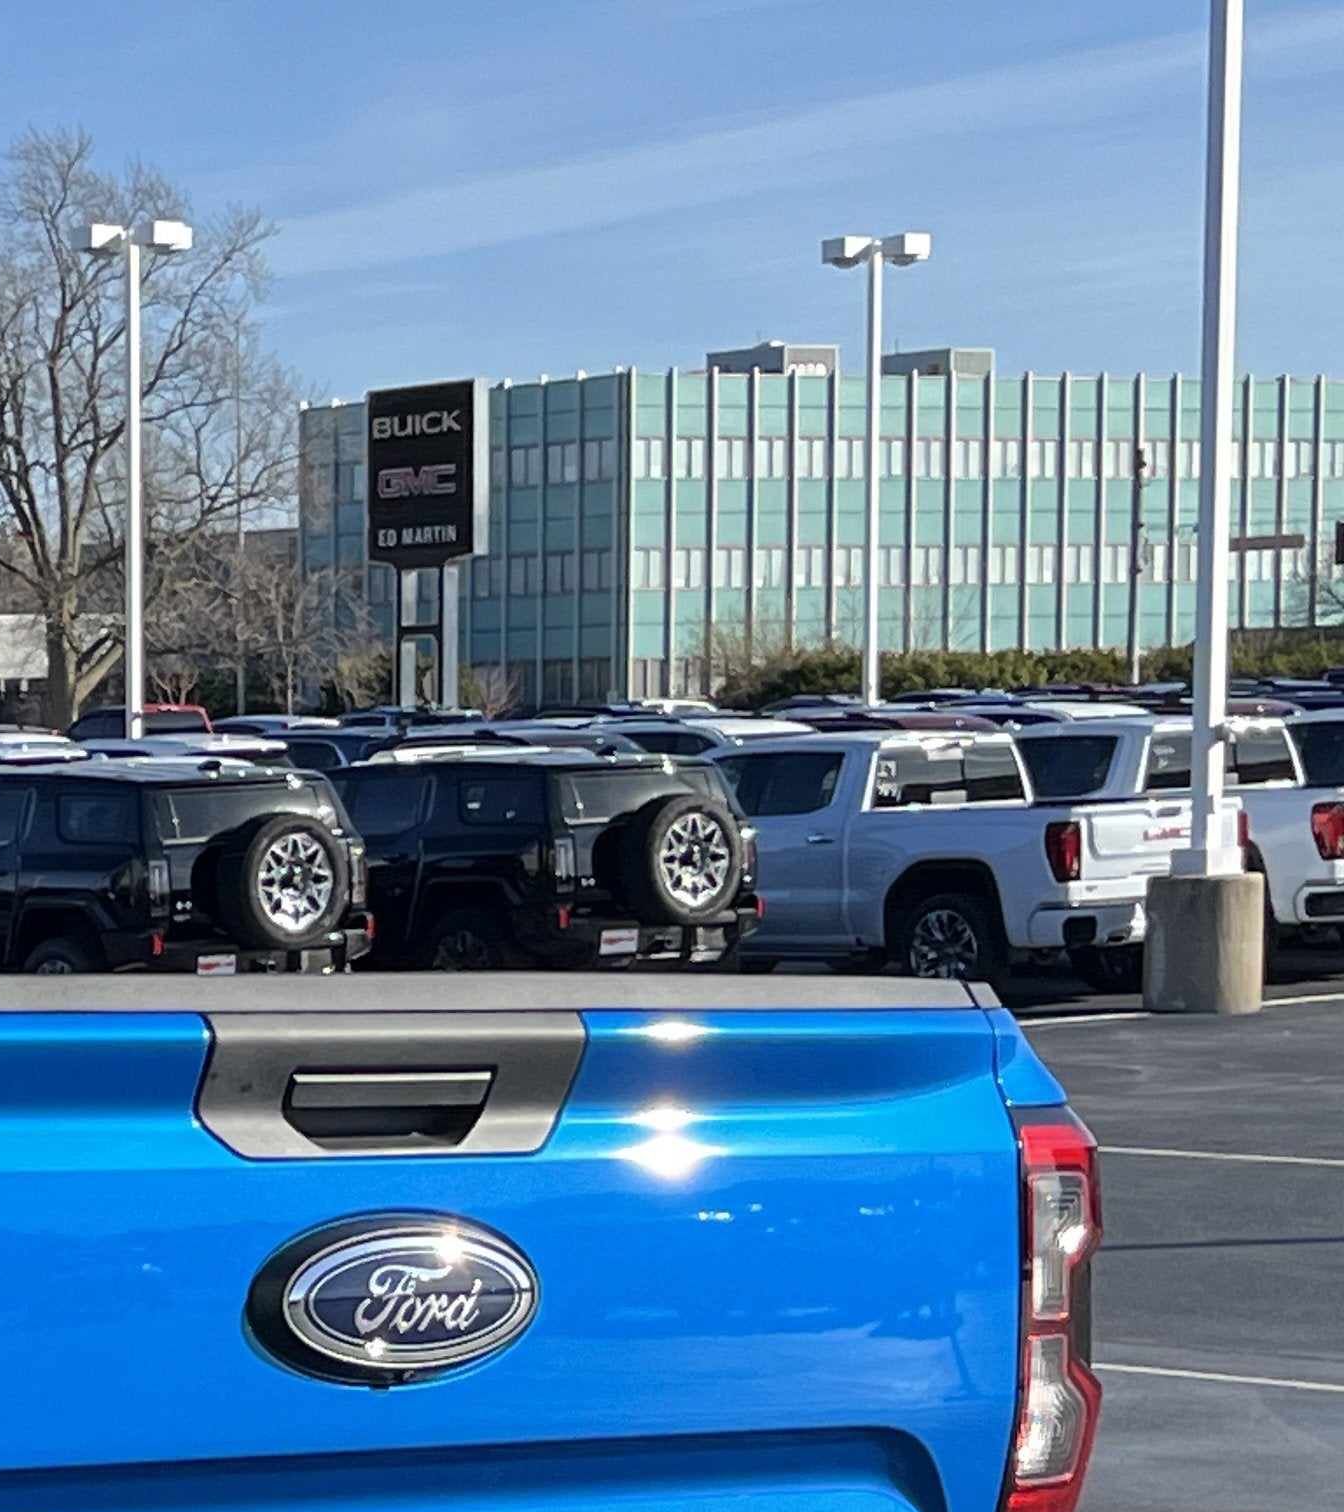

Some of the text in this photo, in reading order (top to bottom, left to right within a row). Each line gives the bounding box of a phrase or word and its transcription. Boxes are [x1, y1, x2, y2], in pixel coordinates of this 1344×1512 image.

[373, 410, 461, 439] BUICK
[378, 464, 456, 498] GMC
[378, 525, 457, 547] ED MARTIN
[354, 1264, 482, 1335] Ford
